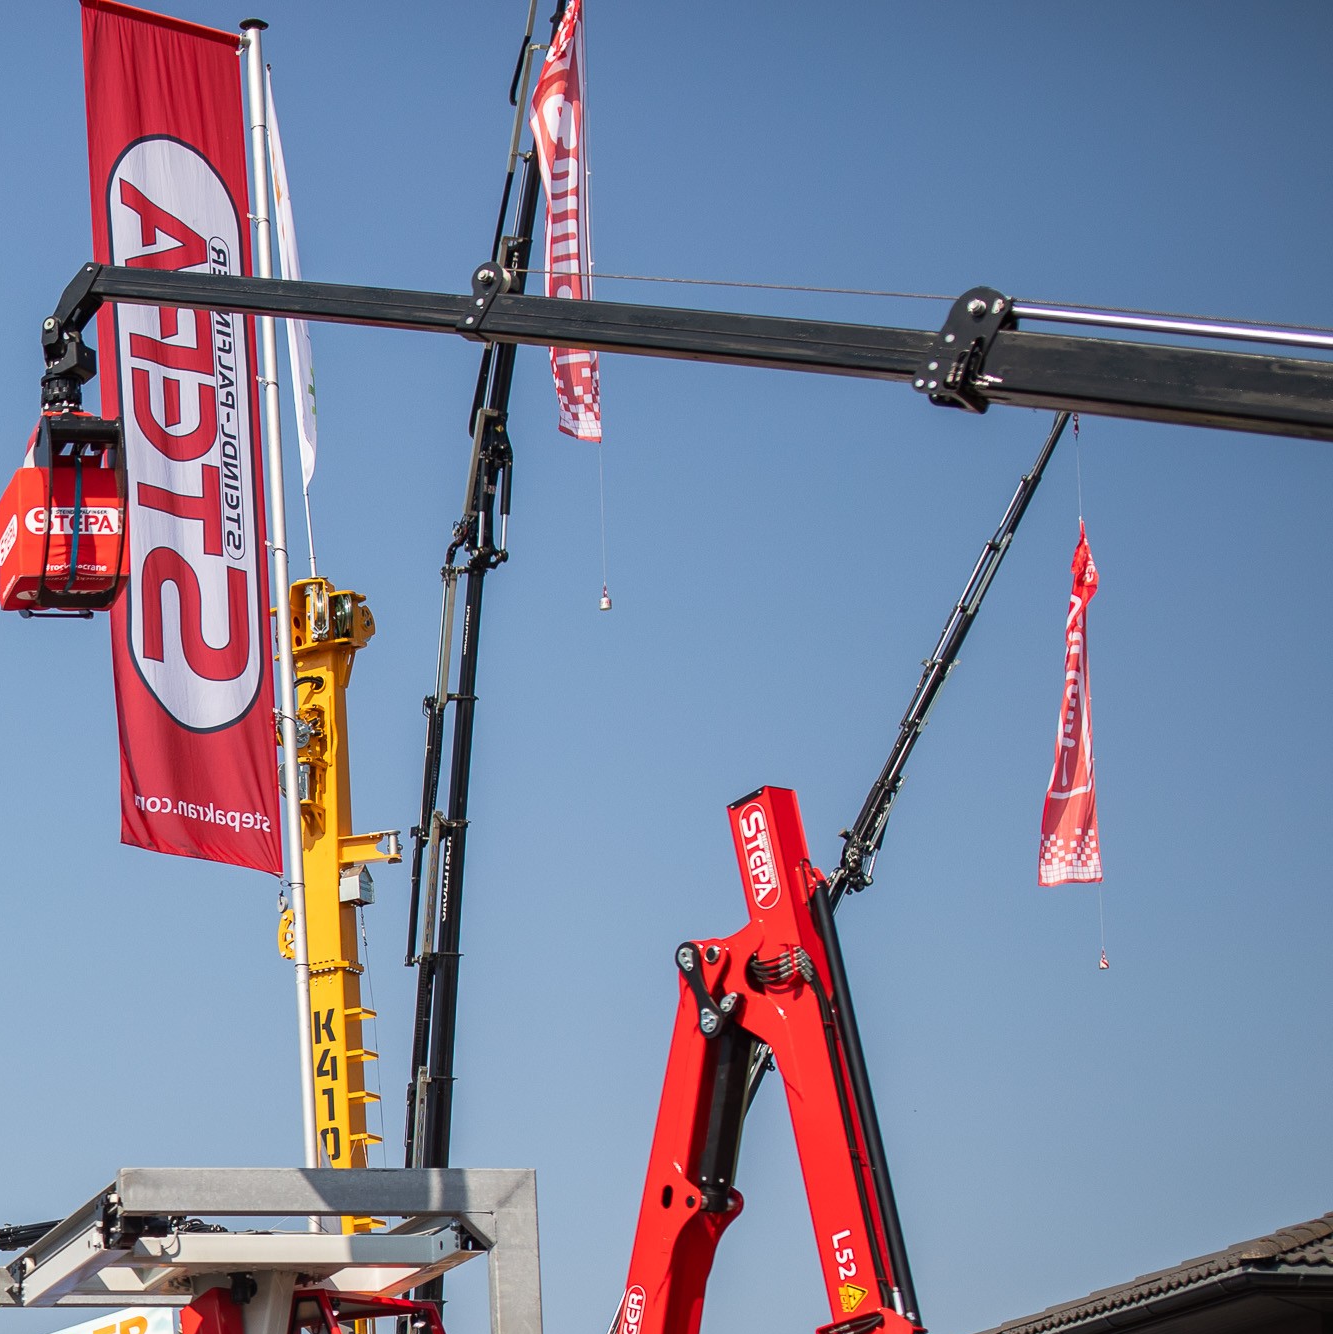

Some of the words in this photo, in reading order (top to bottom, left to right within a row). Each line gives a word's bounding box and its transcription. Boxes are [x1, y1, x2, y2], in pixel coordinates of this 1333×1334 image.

[741, 811, 773, 902] STEPA
[312, 1008, 340, 1161] K410
[830, 1229, 857, 1278] L52
